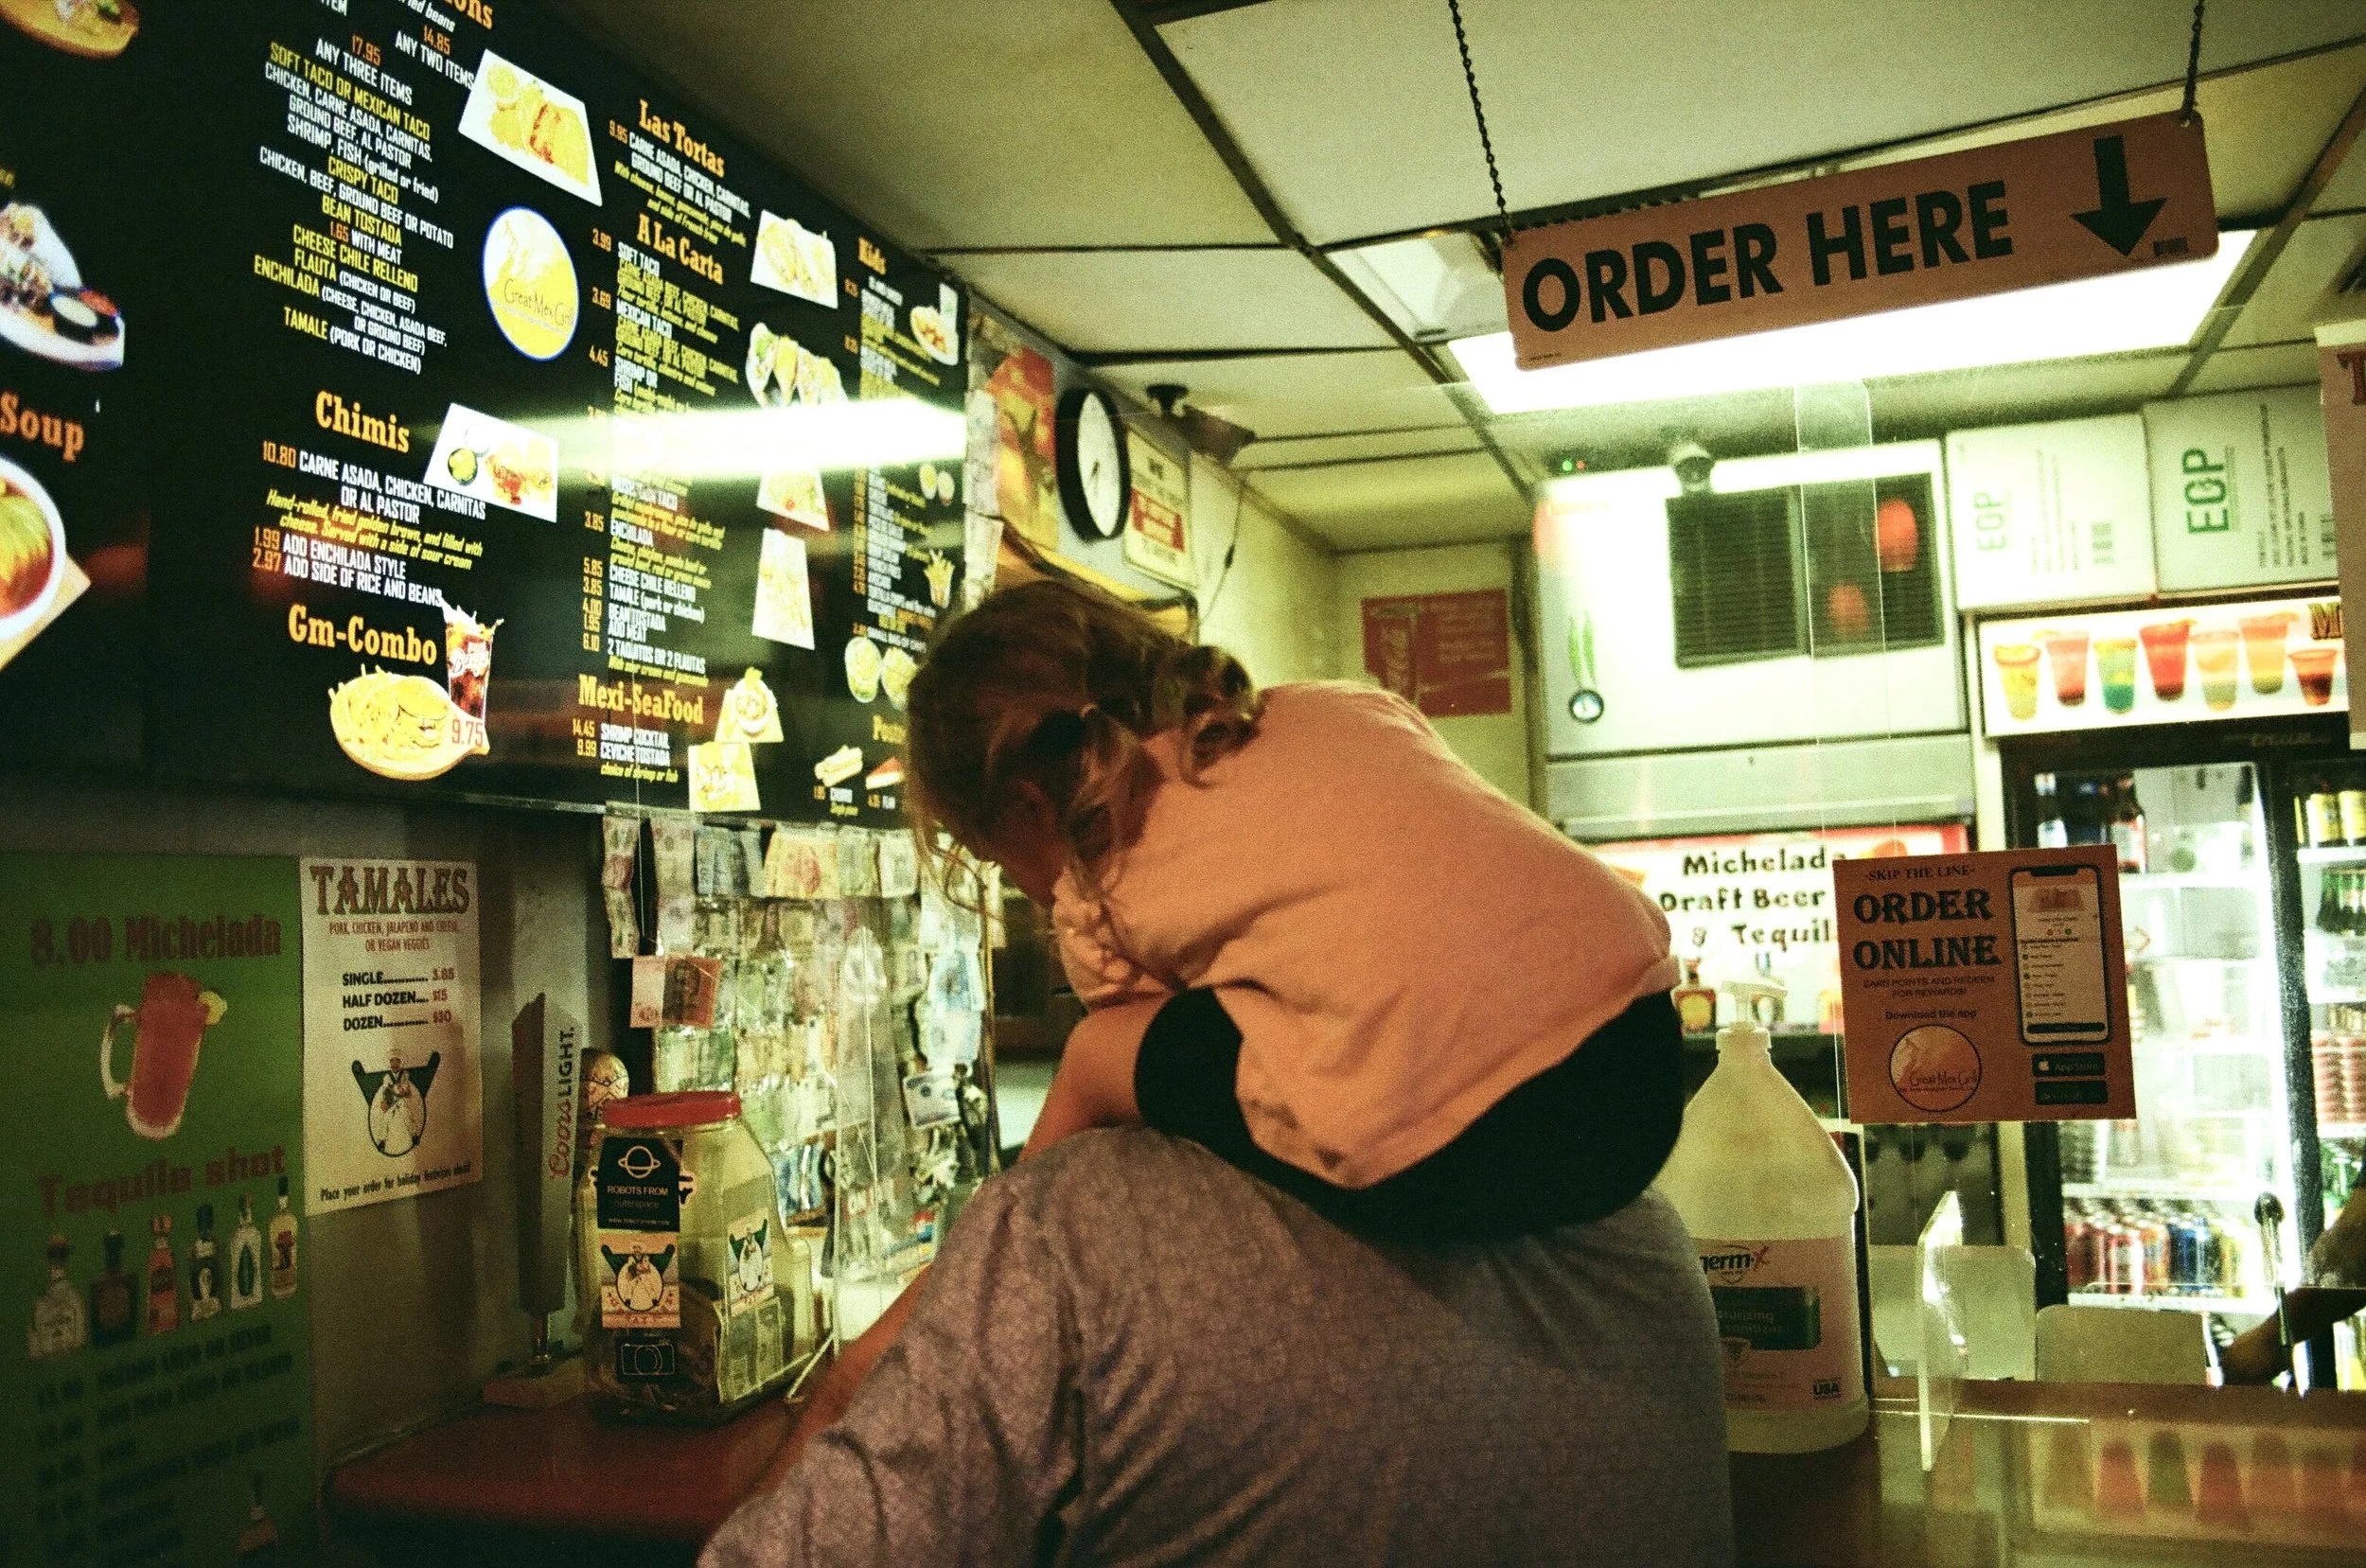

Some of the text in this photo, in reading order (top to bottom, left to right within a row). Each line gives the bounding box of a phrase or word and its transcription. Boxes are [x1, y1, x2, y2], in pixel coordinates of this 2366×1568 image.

[350, 33, 381, 66] 17.95
[395, 30, 474, 91] ANY TWO ITEMS
[423, 24, 451, 56] 14.85
[270, 41, 430, 142] SOFT TACO OR MEXICAN TACO
[315, 38, 413, 106] ANY THREE ITEMS
[314, 87, 347, 118] CARNE
[289, 94, 412, 169] GROUND AL PASTOR
[639, 97, 724, 178] Las Tortas
[327, 155, 398, 205] CRISPY TACO
[337, 138, 411, 189] FISH or
[322, 195, 402, 246] BEAN TOSTADA
[339, 183, 454, 249] GROUND BEEF OR POTATO
[293, 223, 418, 293] CHEESE CHILE RELLENO
[351, 228, 402, 266] WITH MEAT
[618, 241, 661, 277] SOFT TACO
[637, 213, 650, 245] A
[654, 221, 676, 259] La
[680, 237, 724, 285] Carta
[1521, 180, 2015, 333] ORDER HERE
[254, 254, 426, 339] ENCHILADA ASADA
[294, 247, 392, 305] FLAUTA OR
[284, 306, 377, 358] TAMALE OR
[353, 315, 401, 346] OR GROUND
[617, 298, 673, 340] MEXICAN TACO
[0, 390, 85, 463] Soup
[315, 388, 410, 453] Chimis
[262, 440, 486, 520] 10.80 CARNE CARNITAS
[341, 484, 420, 524] OR AL PASTOR
[254, 526, 407, 581] 1.99 ADD ENCHILADA STYLE
[359, 532, 472, 571] with a side of sour cream
[423, 531, 484, 557] and with
[284, 556, 442, 608] ADD SIDE OF RICE AND BEANS
[609, 563, 662, 594] CHEESE CHILE
[609, 581, 640, 606] TAMALE
[289, 604, 438, 665] Gm-Combo
[608, 637, 674, 668] 2 2
[578, 673, 704, 725] Mexi-SeaFood
[451, 718, 484, 748] 9.75
[601, 740, 635, 763] CEVICHE
[309, 865, 470, 916] TAMALES
[1906, 867, 1933, 879] THE
[1659, 886, 1827, 913] Draft Beer
[1853, 888, 1994, 925] ORDER
[124, 913, 282, 961] Michelada
[1852, 934, 2003, 971] ONLINE
[343, 994, 372, 1009] HALF
[1885, 1009, 1977, 1021] Download the app
[557, 1029, 574, 1098] LIGHT
[548, 1100, 573, 1180] Coors
[205, 1143, 287, 1189] shot
[607, 1185, 669, 1197] ROBOTS FROM
[1812, 1383, 1840, 1397] USA
